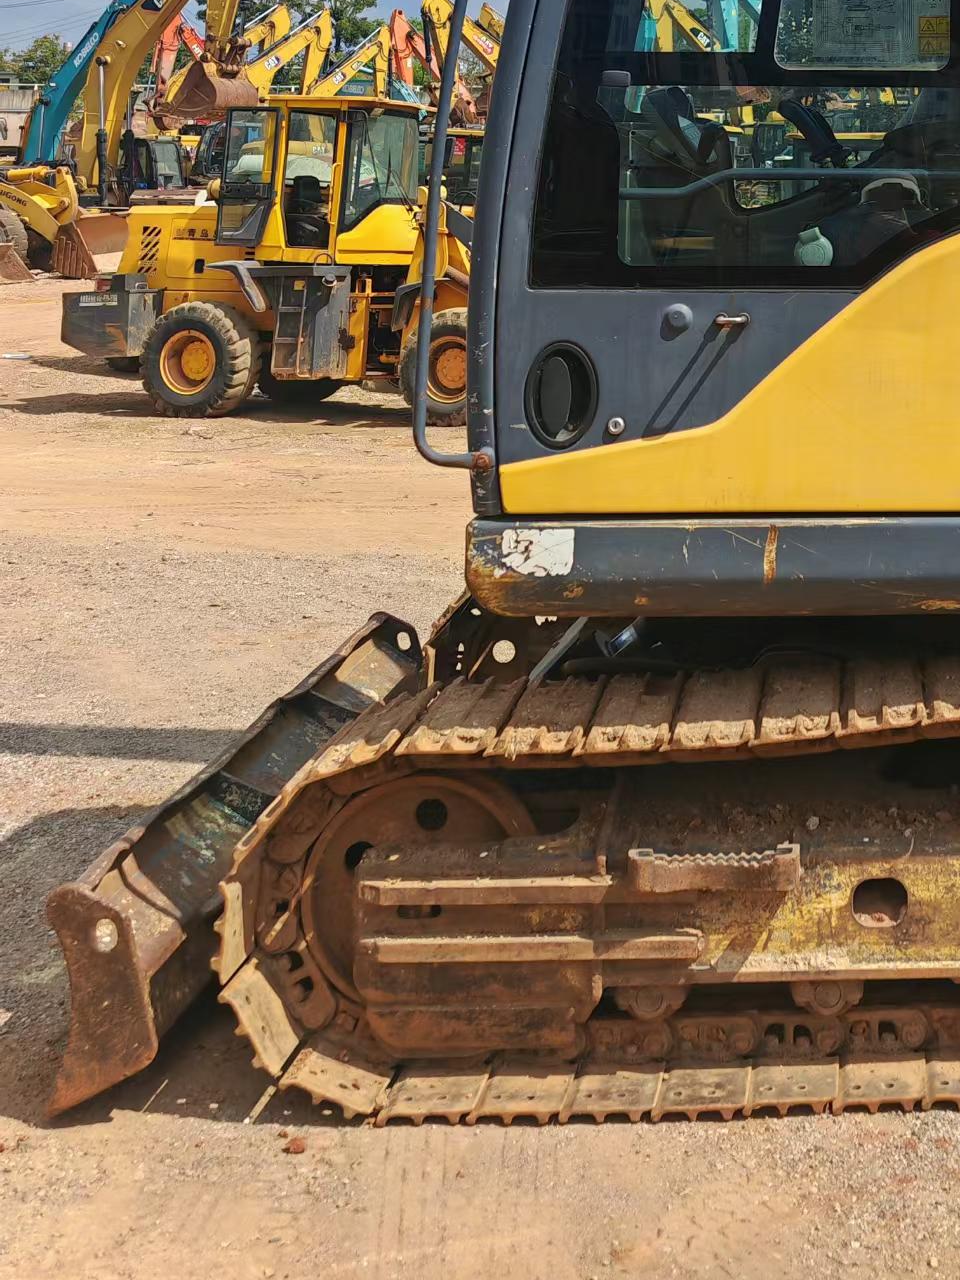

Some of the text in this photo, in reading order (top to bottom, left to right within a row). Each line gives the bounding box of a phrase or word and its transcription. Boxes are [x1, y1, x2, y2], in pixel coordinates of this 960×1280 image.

[697, 32, 710, 47] CAT
[73, 32, 99, 68] KOBELCO
[264, 55, 279, 71] CAT
